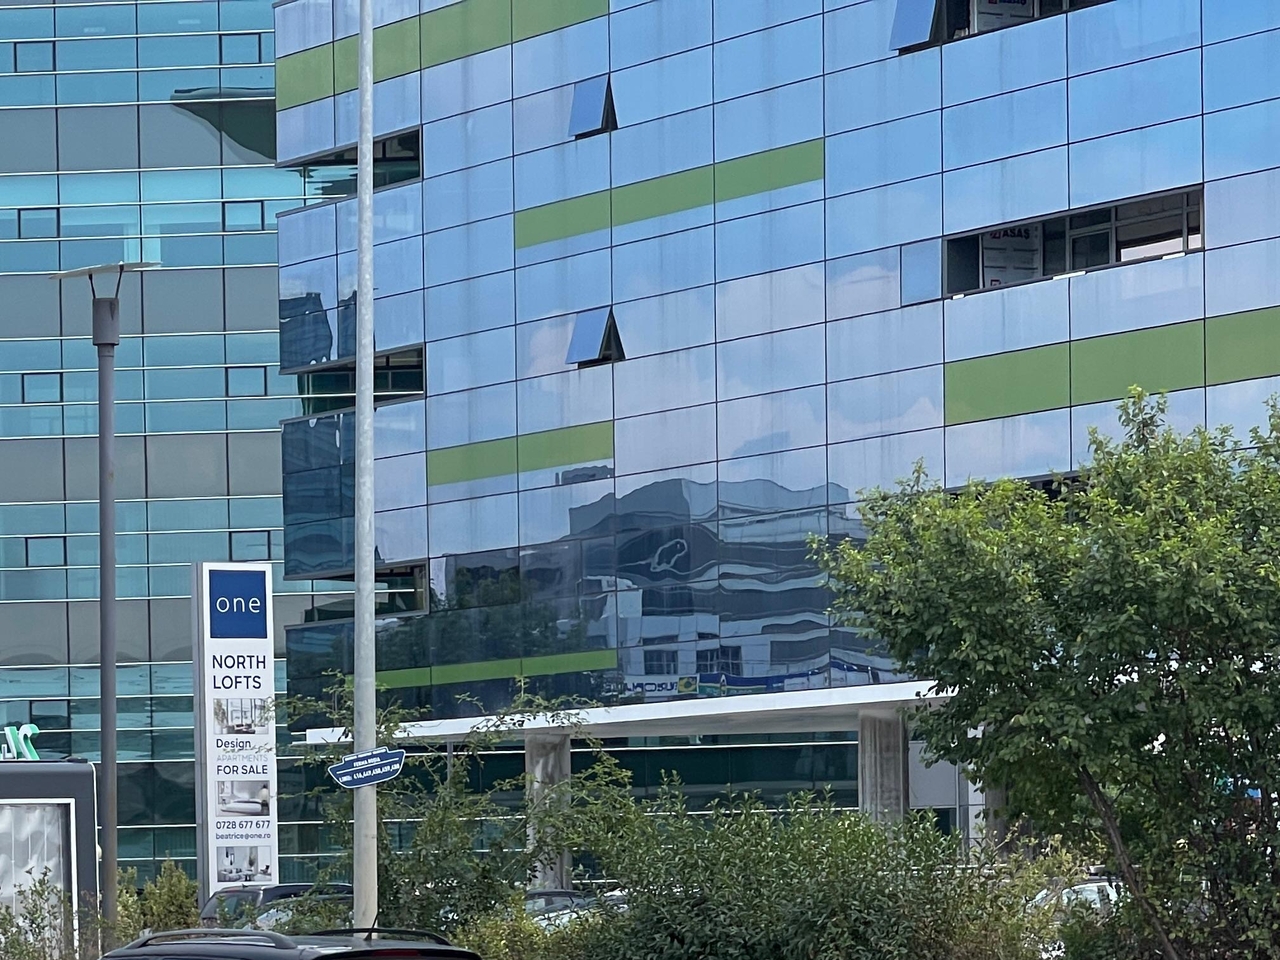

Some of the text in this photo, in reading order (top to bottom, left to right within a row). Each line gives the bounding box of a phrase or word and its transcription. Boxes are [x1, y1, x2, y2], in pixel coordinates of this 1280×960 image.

[216, 595, 261, 613] one
[212, 654, 266, 670] NORTH
[213, 675, 262, 690] LOFTS
[216, 738, 251, 750] Design
[216, 754, 268, 762] APARTMENTS
[216, 765, 268, 775] FOR SALE
[216, 820, 271, 830] 0728 677 677
[215, 832, 271, 840] beatrice@one.ro
